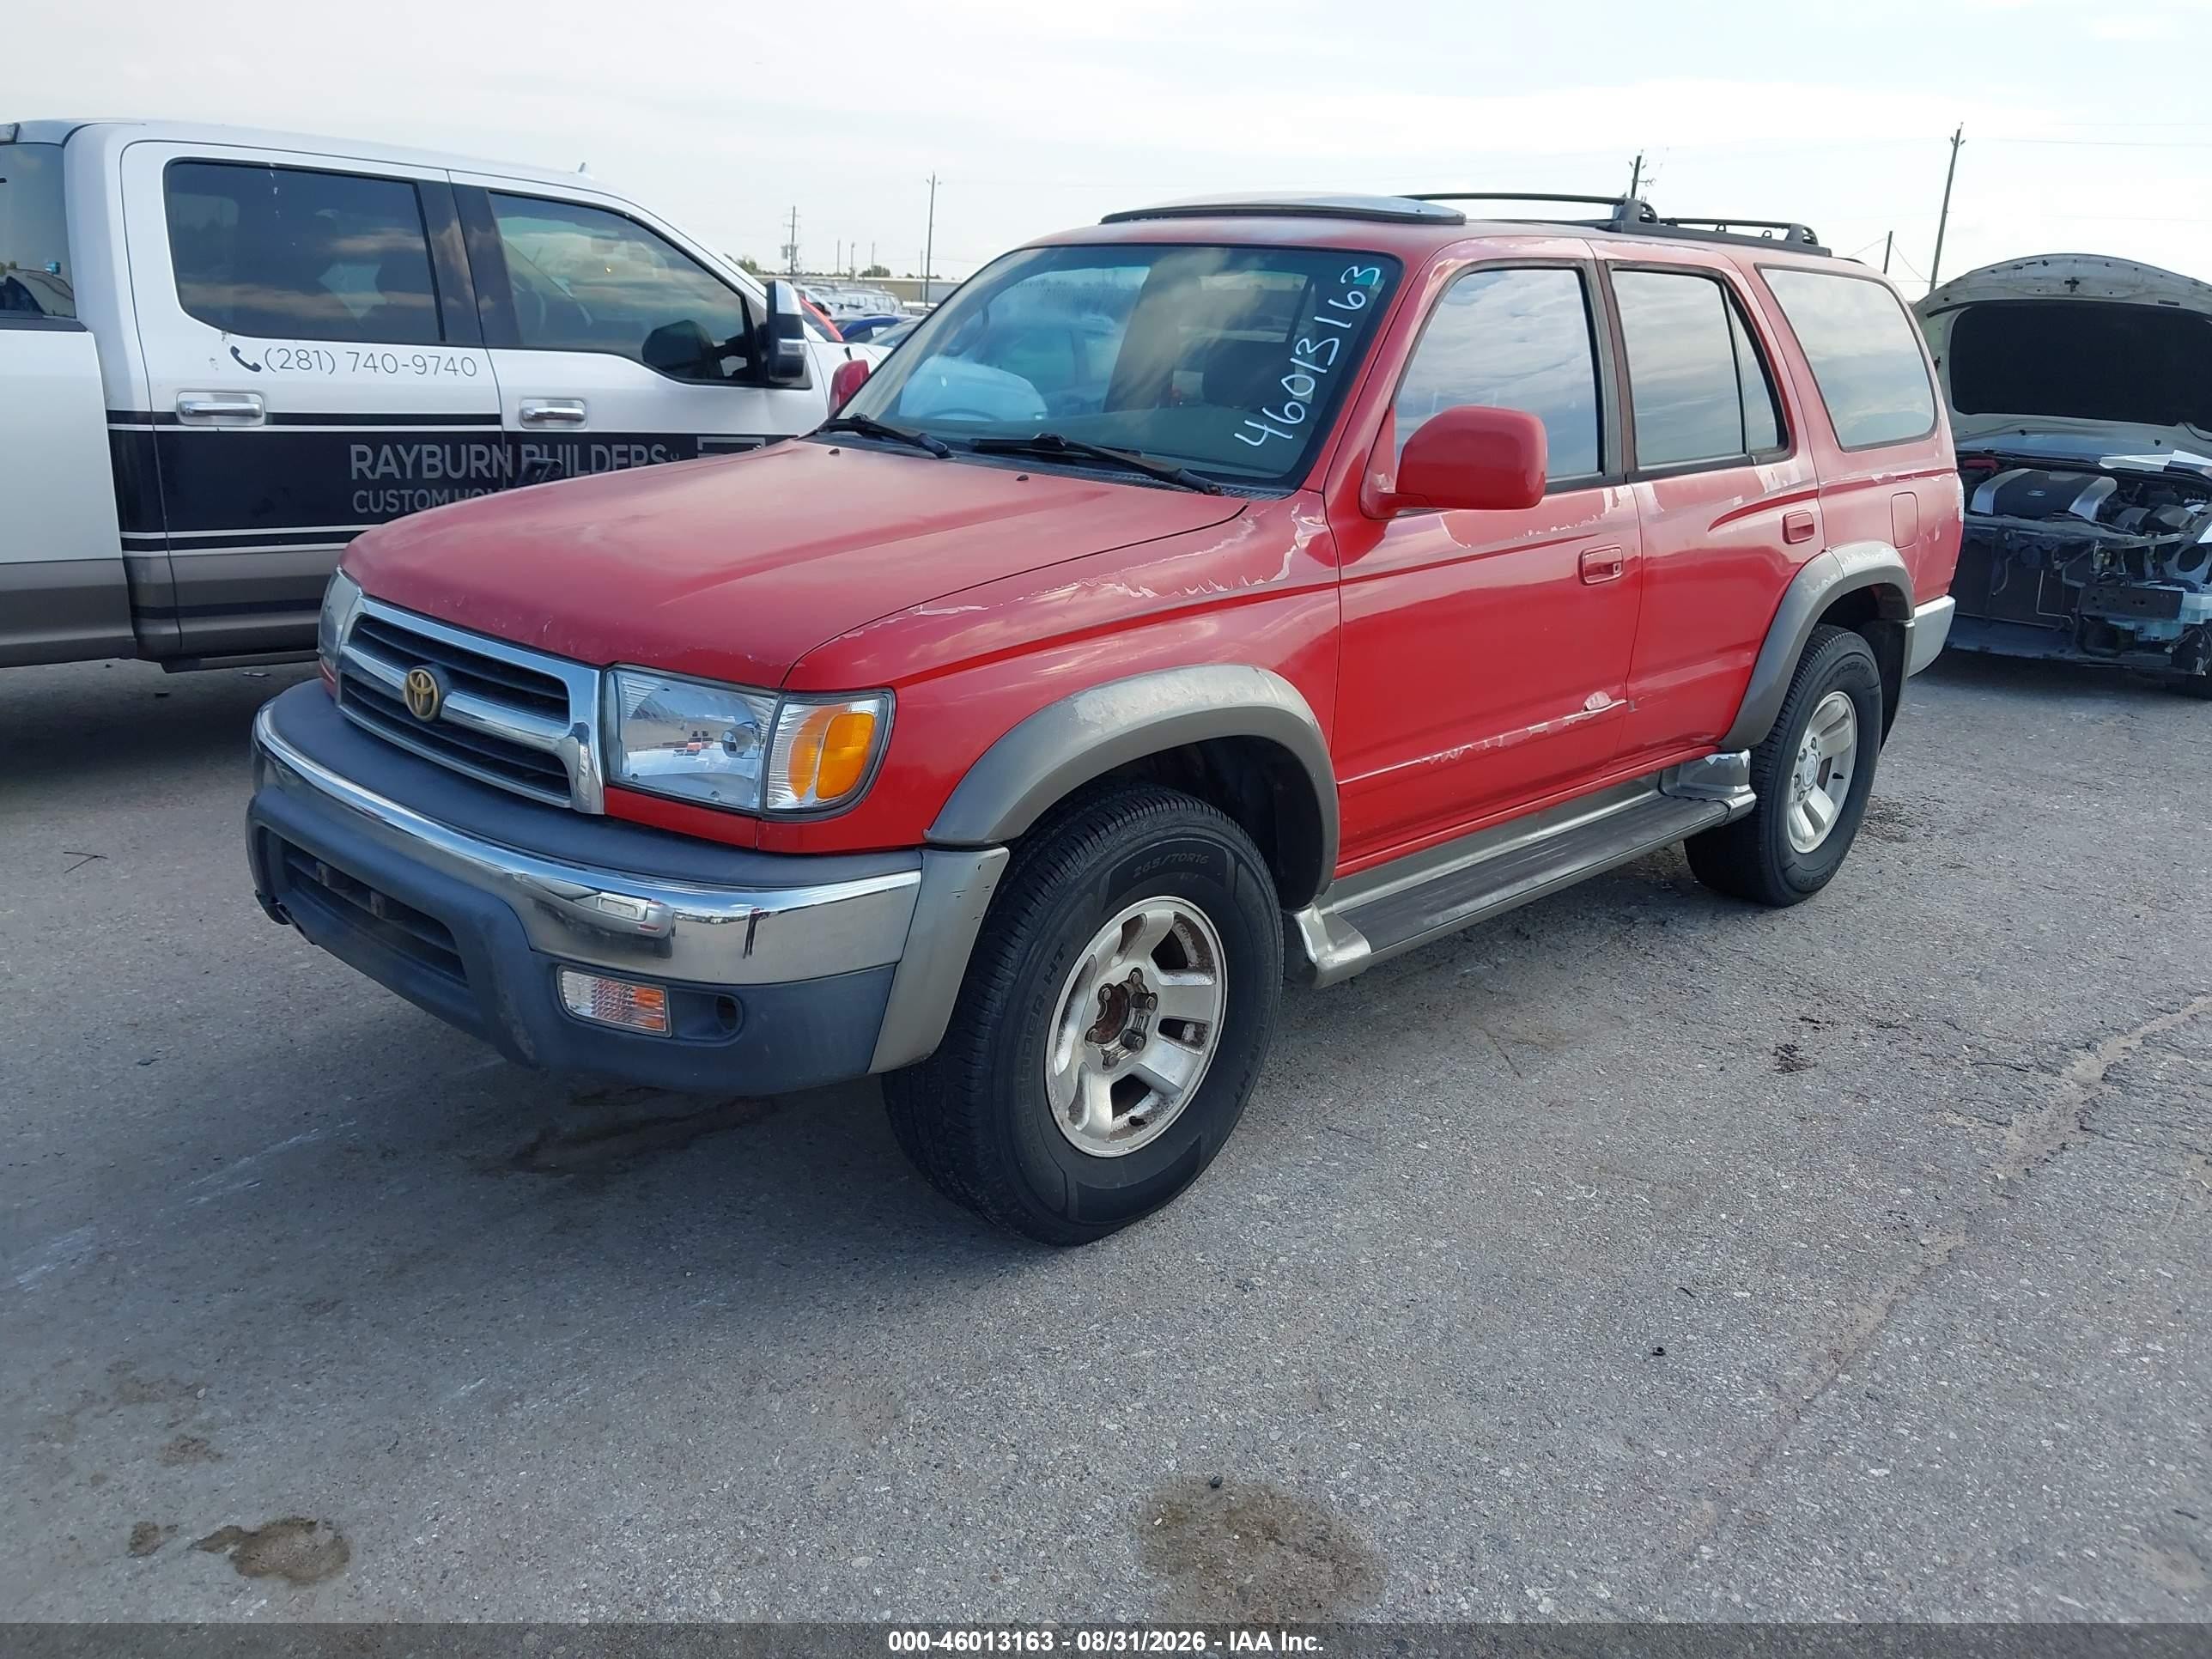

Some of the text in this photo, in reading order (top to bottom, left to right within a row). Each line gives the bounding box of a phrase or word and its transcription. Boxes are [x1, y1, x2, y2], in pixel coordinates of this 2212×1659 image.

[264, 347, 477, 377] (281) 740-9740
[1234, 265, 1381, 447] 46013163
[350, 443, 513, 480] RAYBURN
[352, 489, 449, 514] CUSTOM
